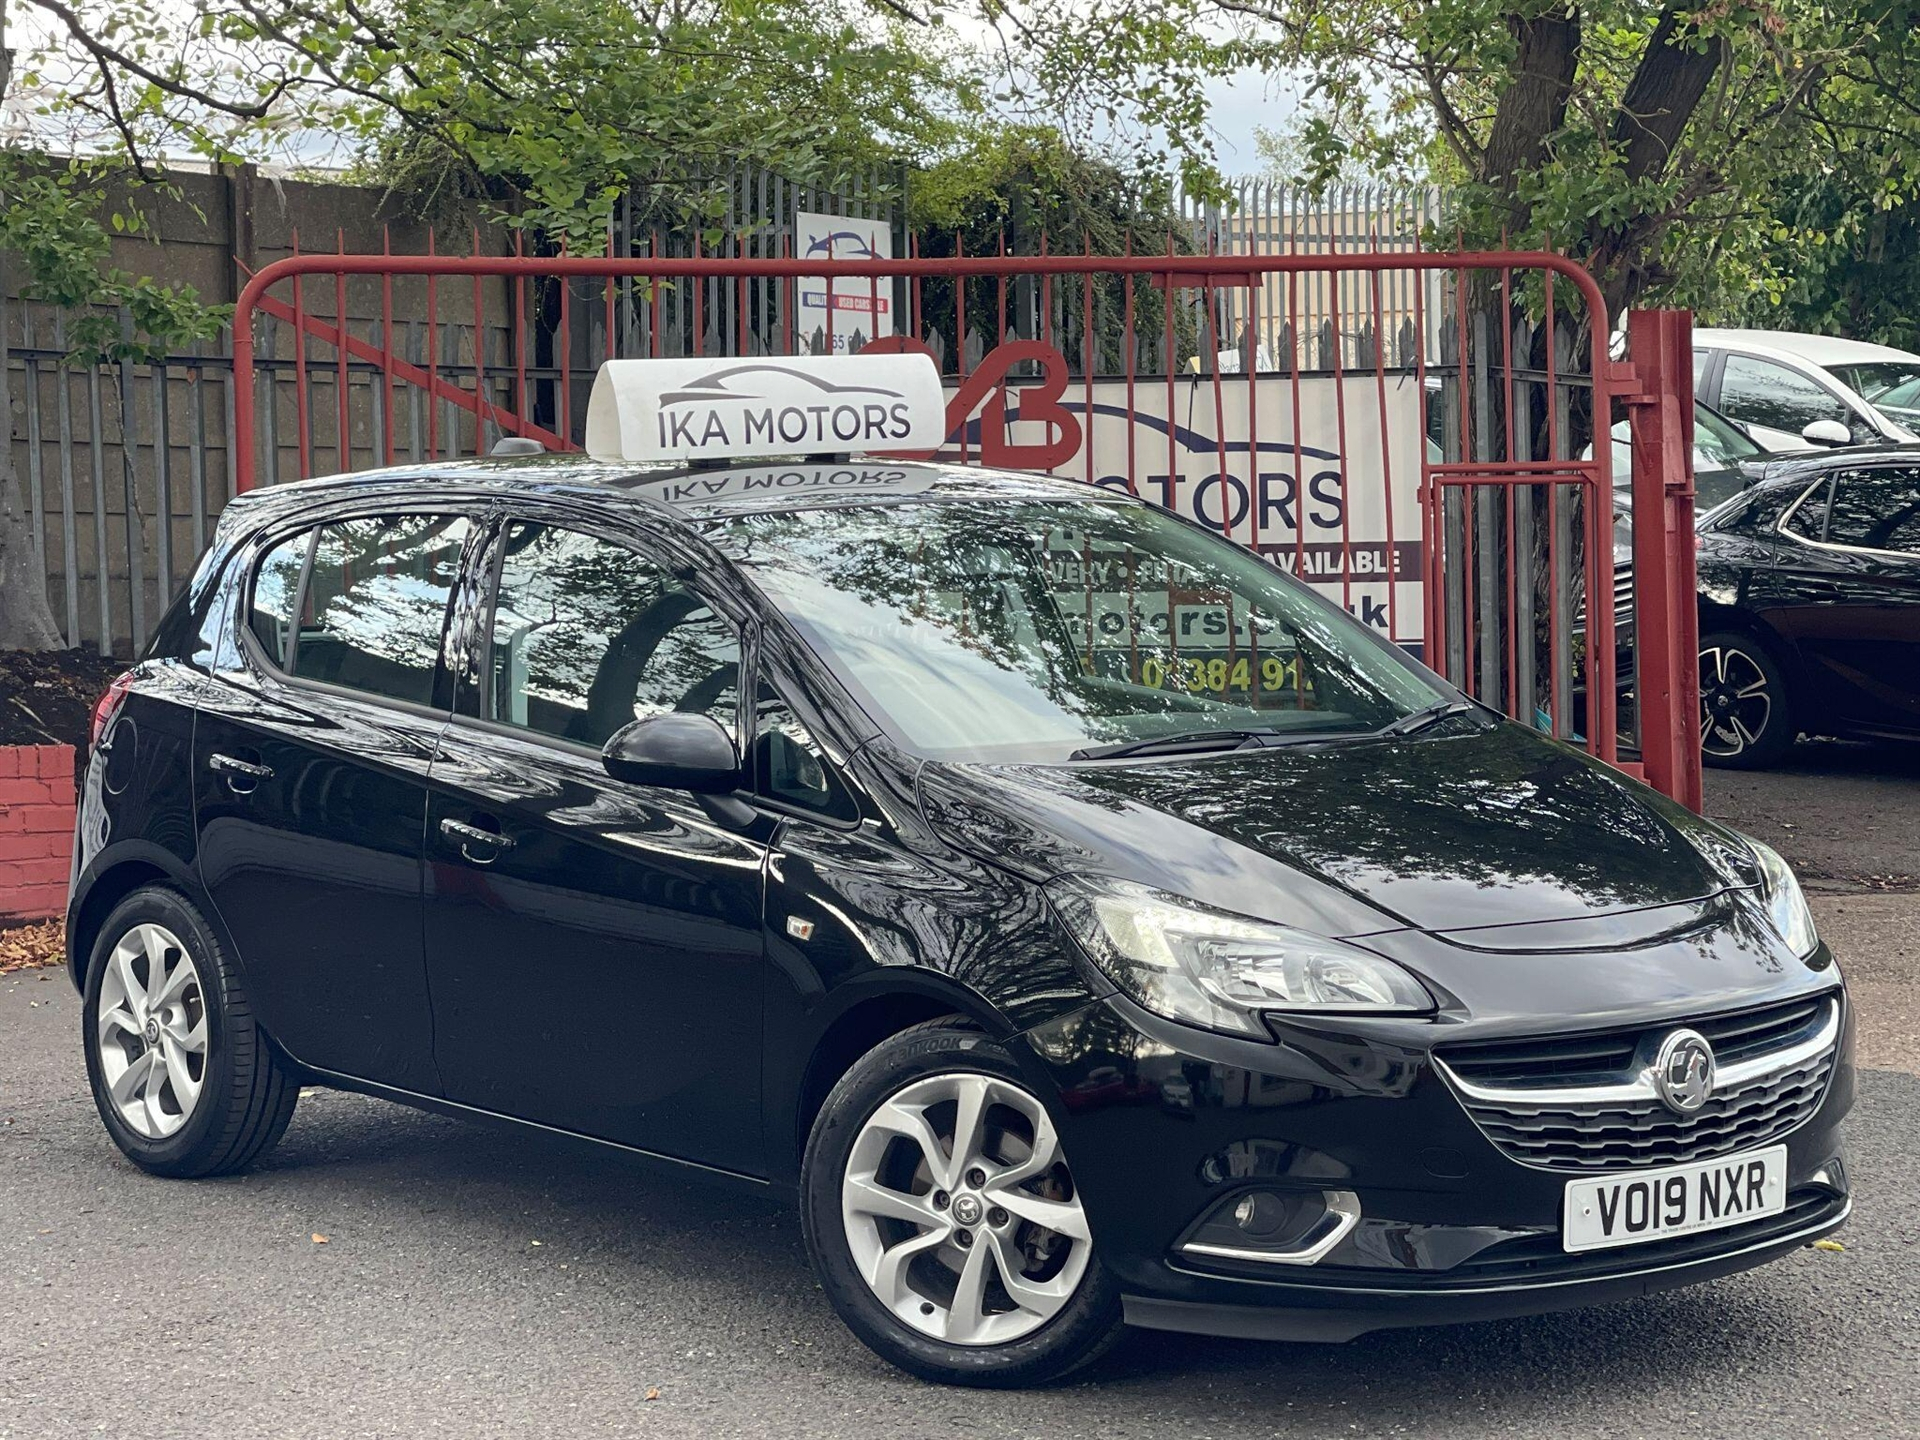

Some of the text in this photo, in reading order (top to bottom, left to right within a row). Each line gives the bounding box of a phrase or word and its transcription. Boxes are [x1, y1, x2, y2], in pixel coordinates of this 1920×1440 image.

[838, 297, 854, 309] USED
[658, 403, 911, 448] IKA MOTORS
[1597, 1160, 1765, 1236] VO19 NXR
